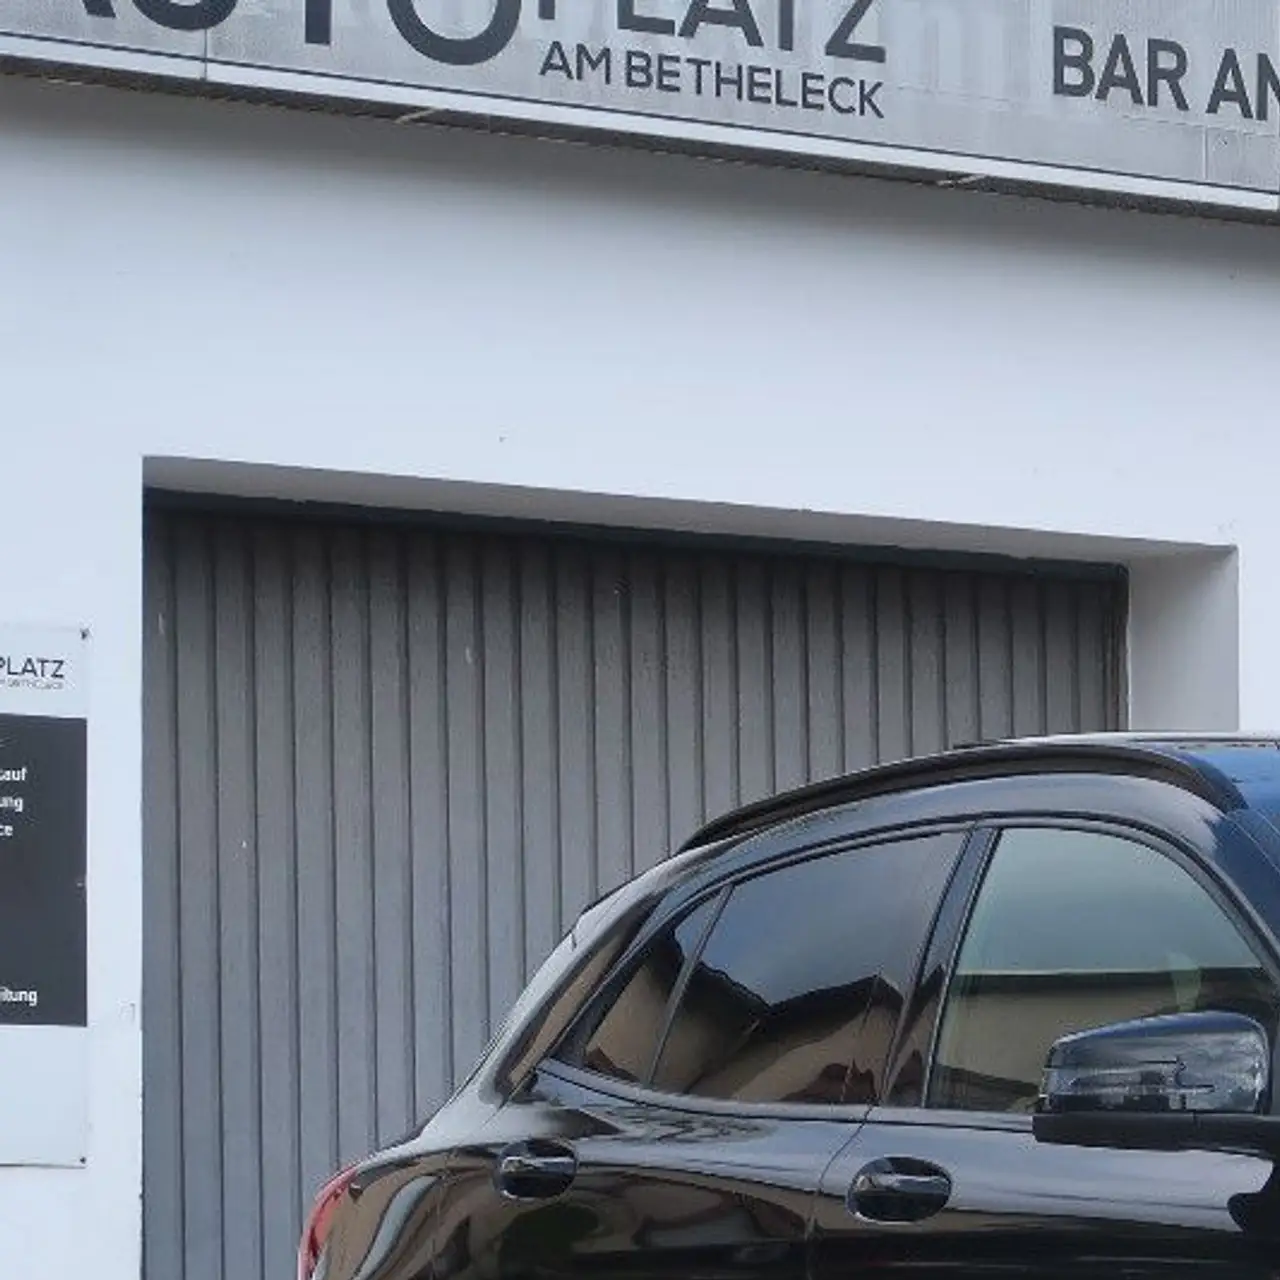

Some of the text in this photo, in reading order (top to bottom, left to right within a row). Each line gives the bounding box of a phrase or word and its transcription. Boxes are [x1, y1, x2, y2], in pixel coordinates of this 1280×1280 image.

[539, 40, 612, 85] AM
[625, 50, 885, 119] BETHELECK
[1053, 26, 1190, 112] BAR
